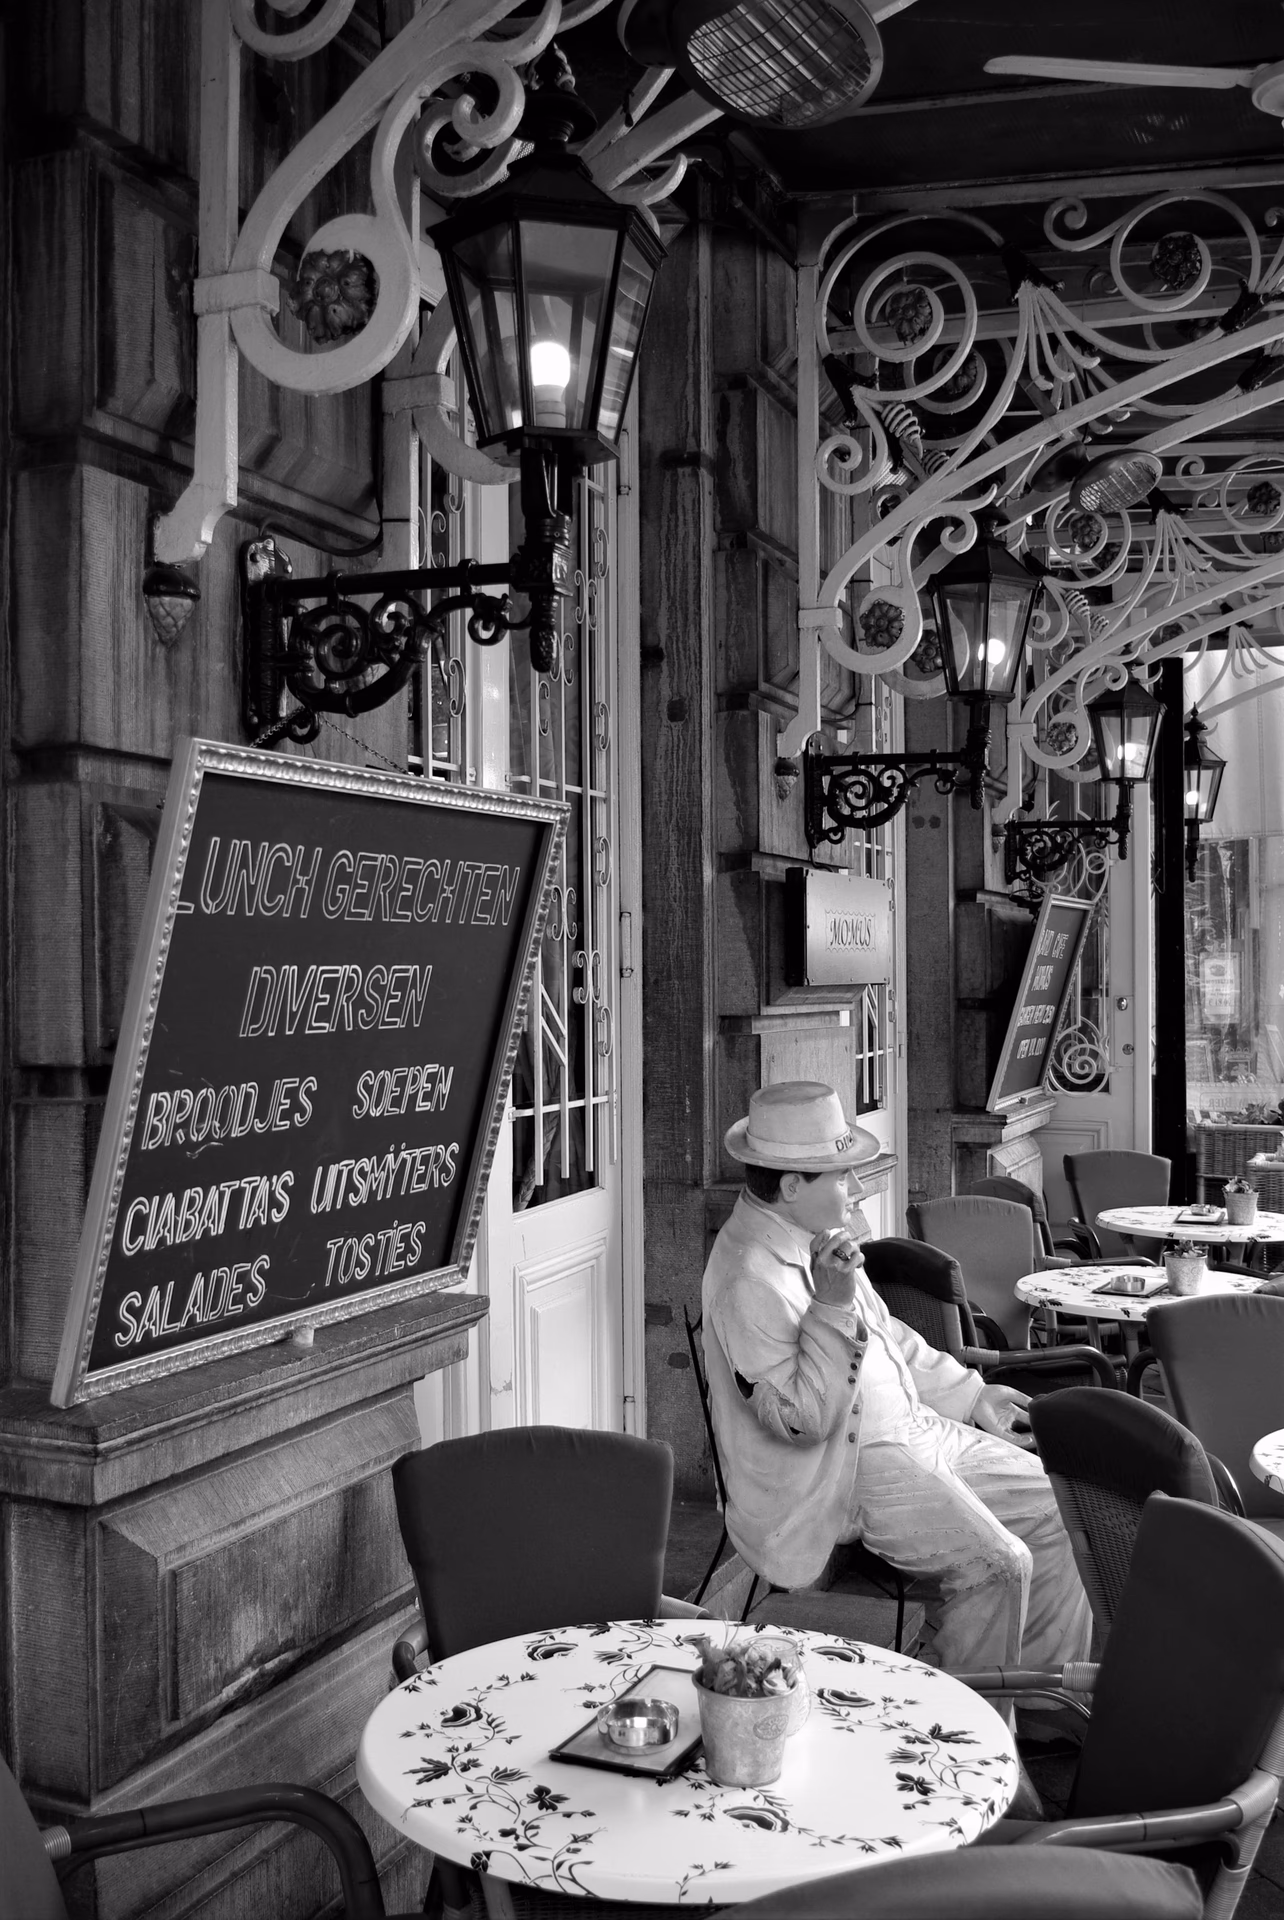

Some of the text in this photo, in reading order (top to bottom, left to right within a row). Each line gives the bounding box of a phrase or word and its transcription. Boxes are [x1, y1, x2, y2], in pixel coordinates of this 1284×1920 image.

[322, 850, 520, 925] GERECHTEN
[830, 917, 872, 946] MOMUS
[239, 965, 433, 1038] DIVERSEN
[140, 1076, 318, 1150] BROODJES
[352, 1063, 455, 1120] SOEPEN
[121, 1170, 295, 1257] CIABATTA'S
[114, 1254, 271, 1348] SALADES
